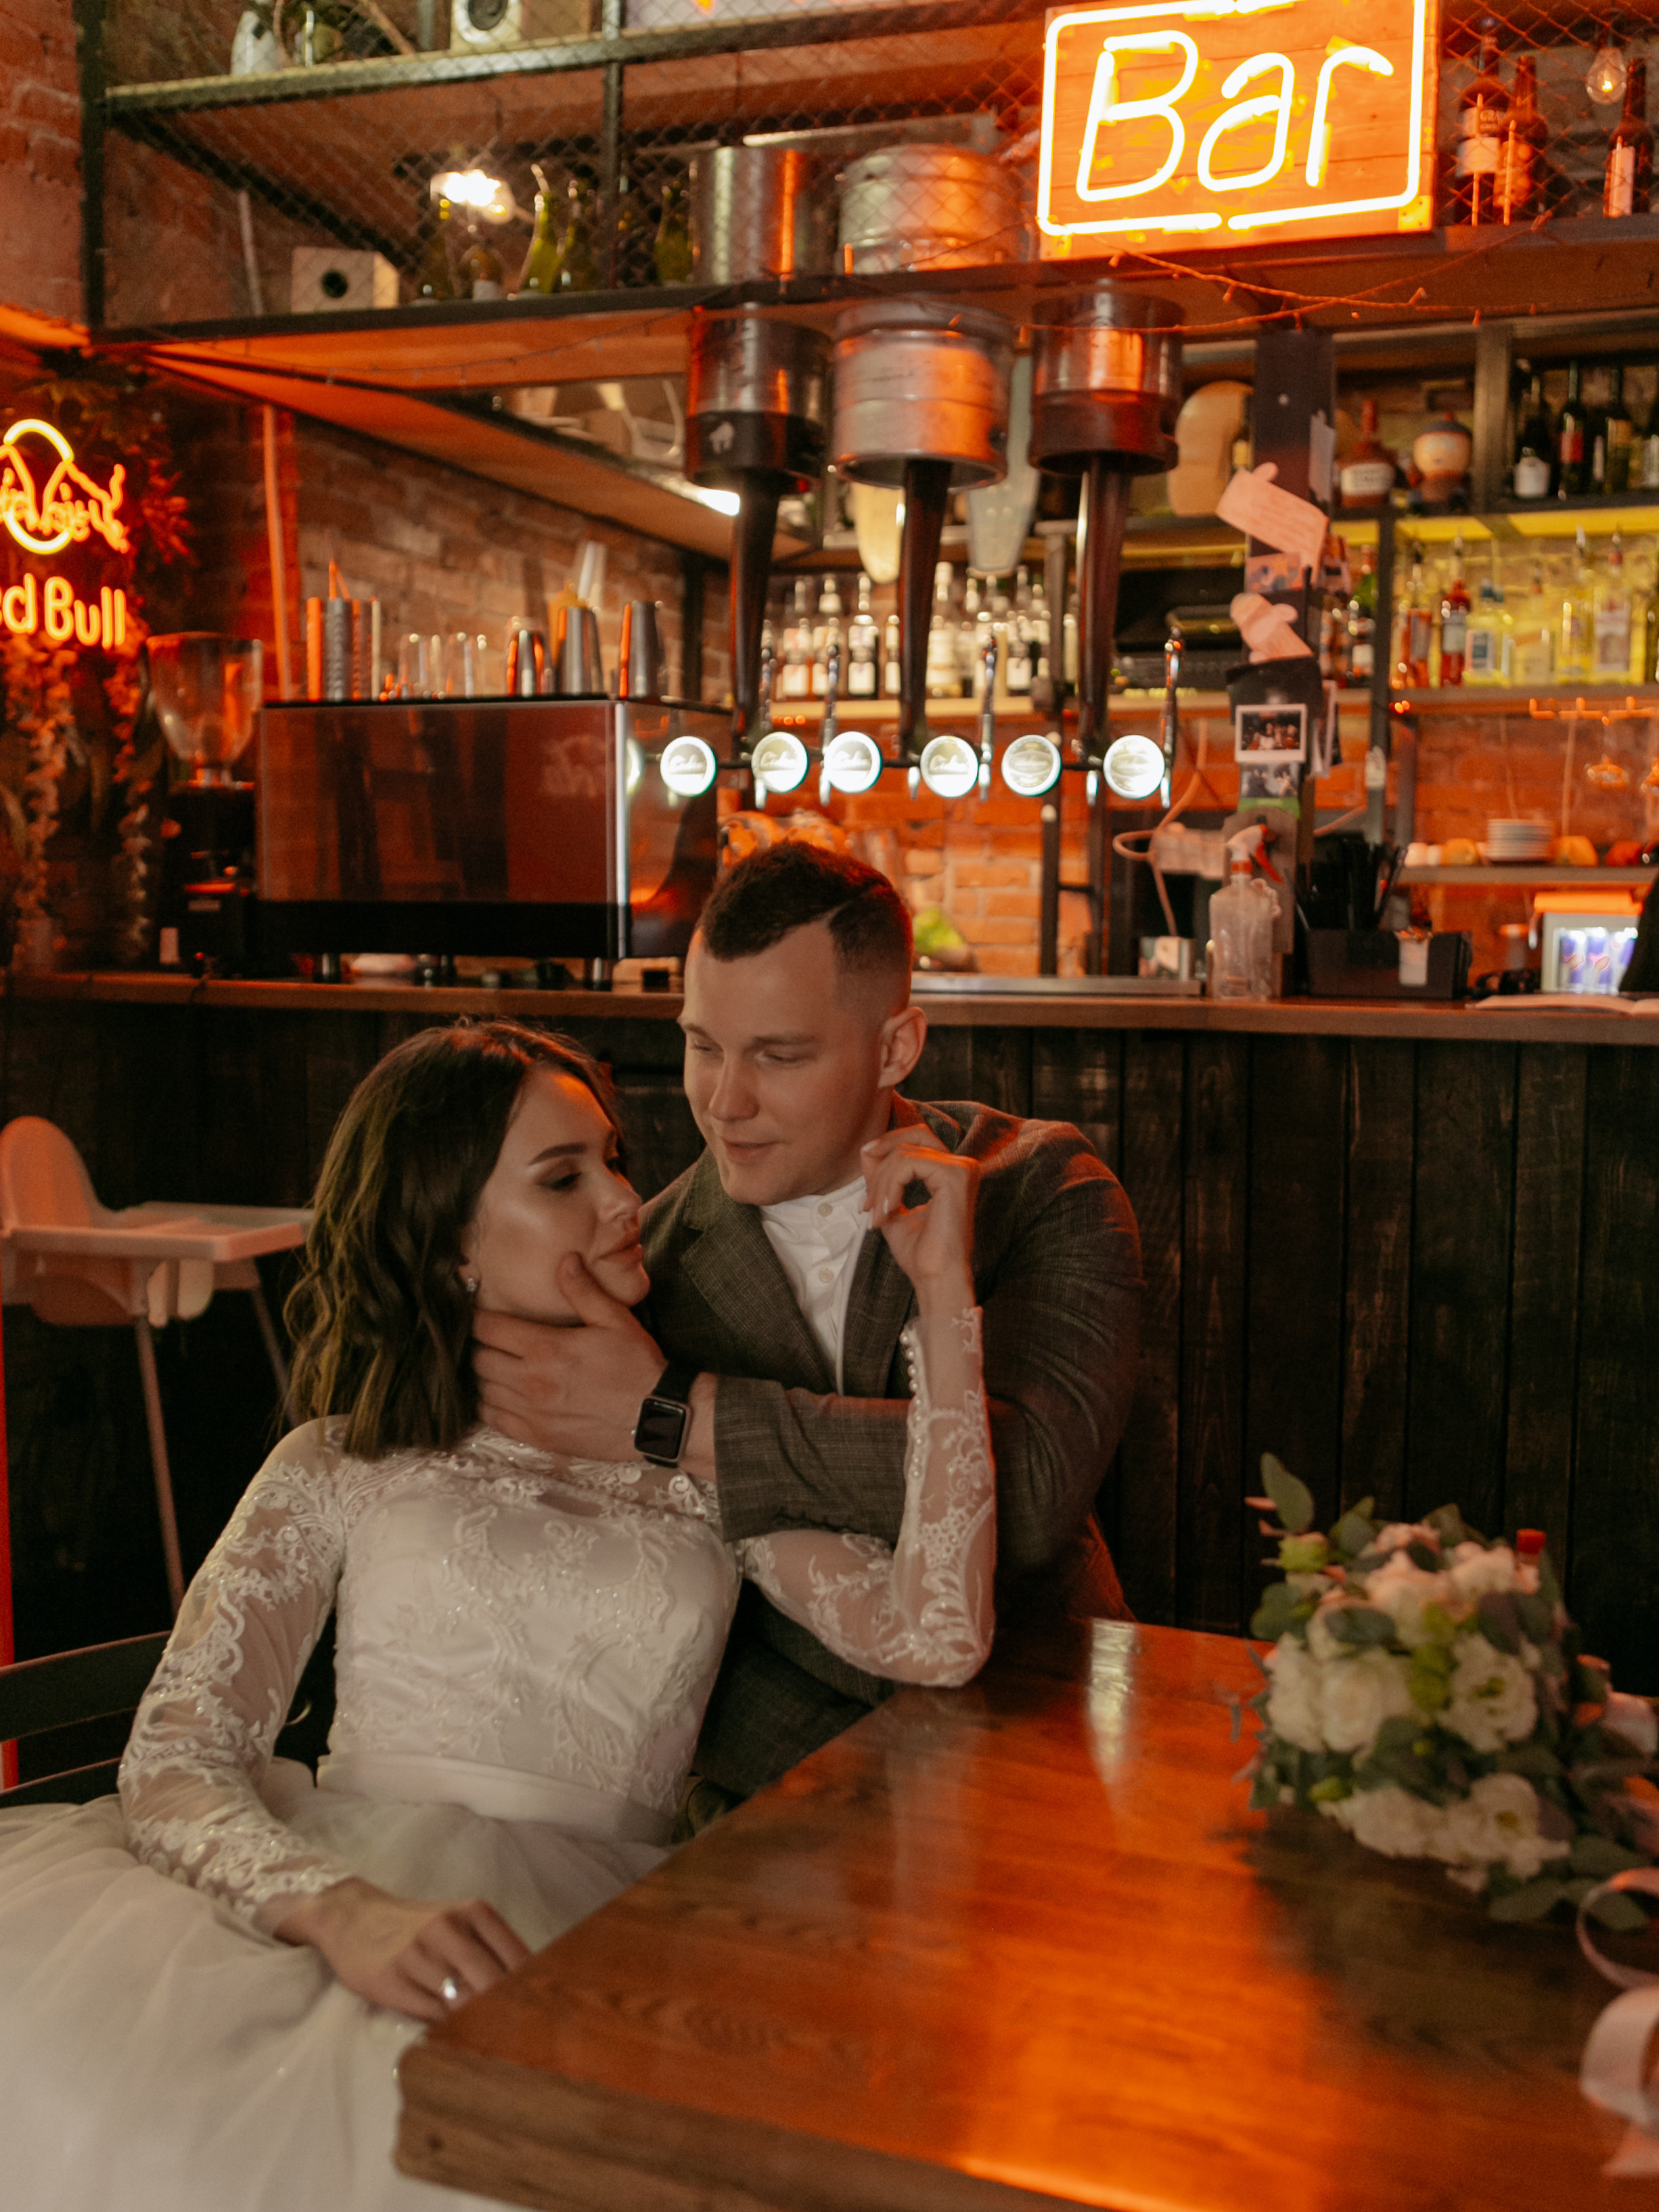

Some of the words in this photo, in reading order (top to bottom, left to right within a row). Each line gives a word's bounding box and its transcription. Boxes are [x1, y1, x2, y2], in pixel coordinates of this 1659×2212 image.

[1076, 29, 1394, 202] Bar
[0, 572, 37, 635] d
[44, 576, 127, 650] Bull
